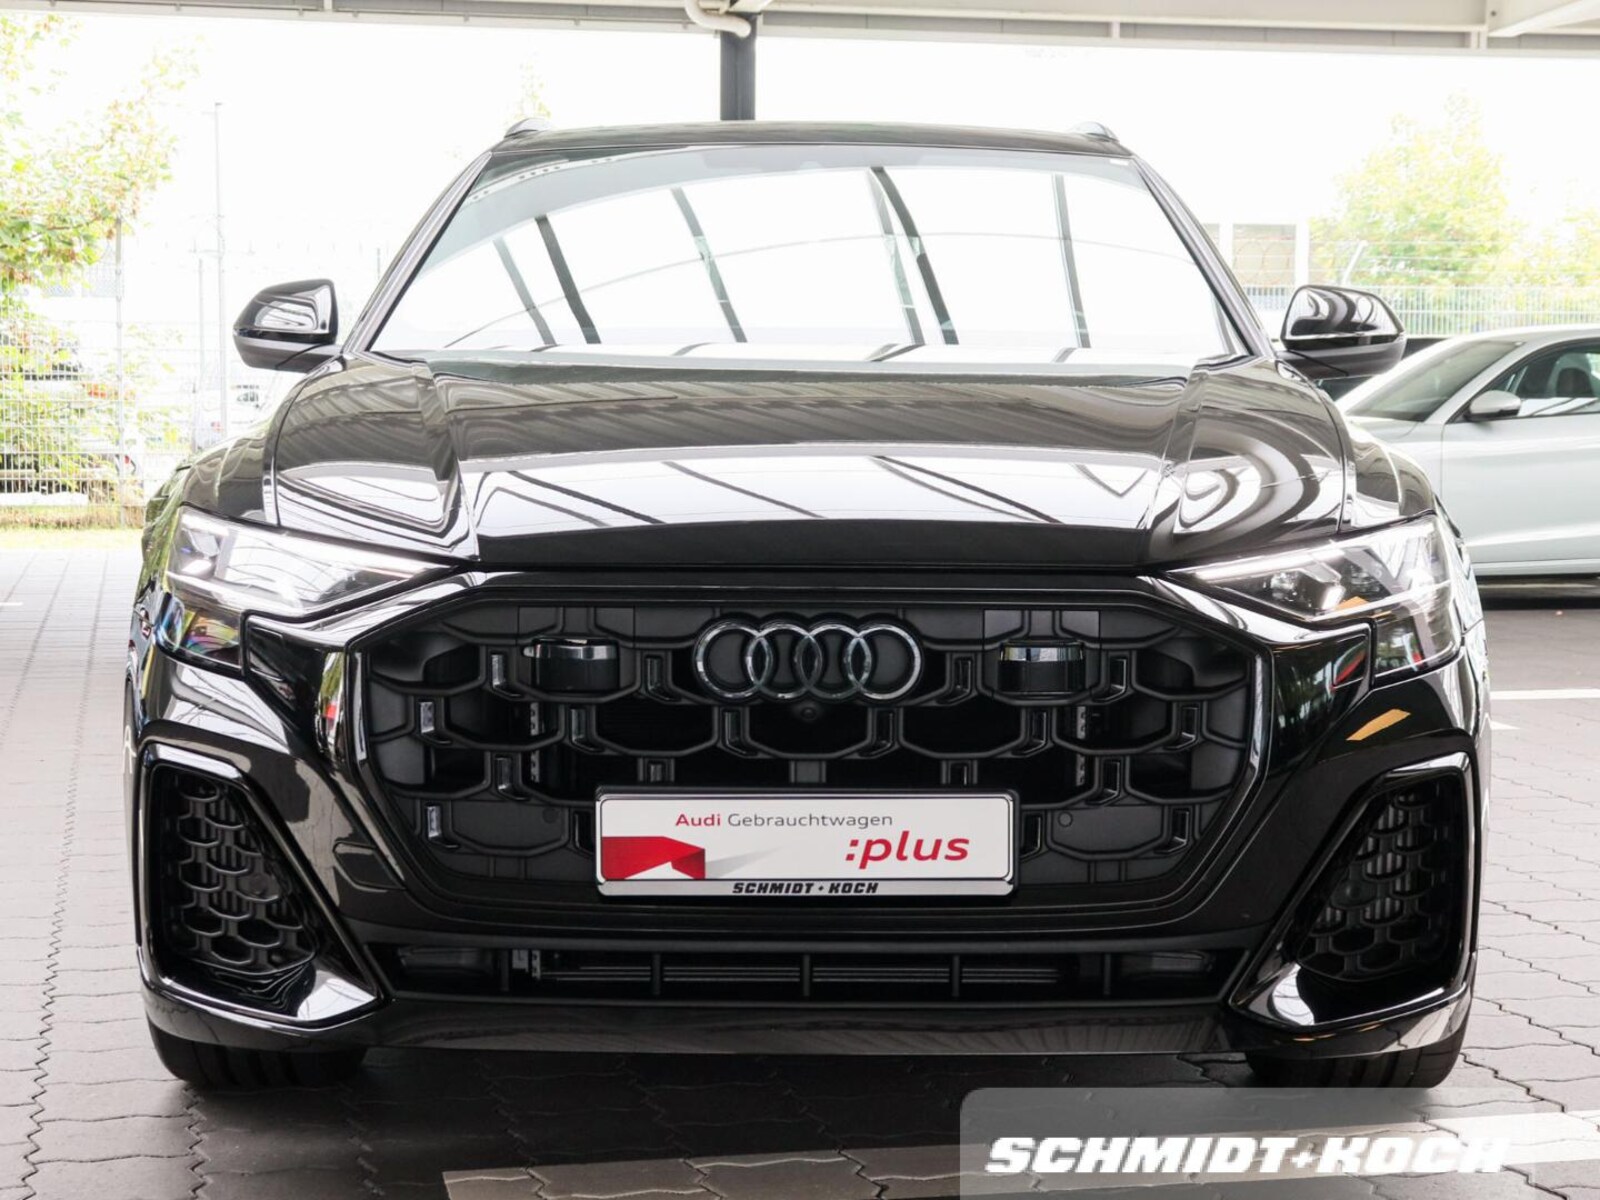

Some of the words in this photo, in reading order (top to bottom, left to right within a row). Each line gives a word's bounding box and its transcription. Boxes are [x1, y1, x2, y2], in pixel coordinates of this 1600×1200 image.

[675, 813, 721, 827] Audi
[728, 813, 893, 829] Gebrauchtwagen
[845, 831, 970, 869] :plus
[732, 882, 814, 894] SCHMIDT
[828, 882, 879, 894] KOCH
